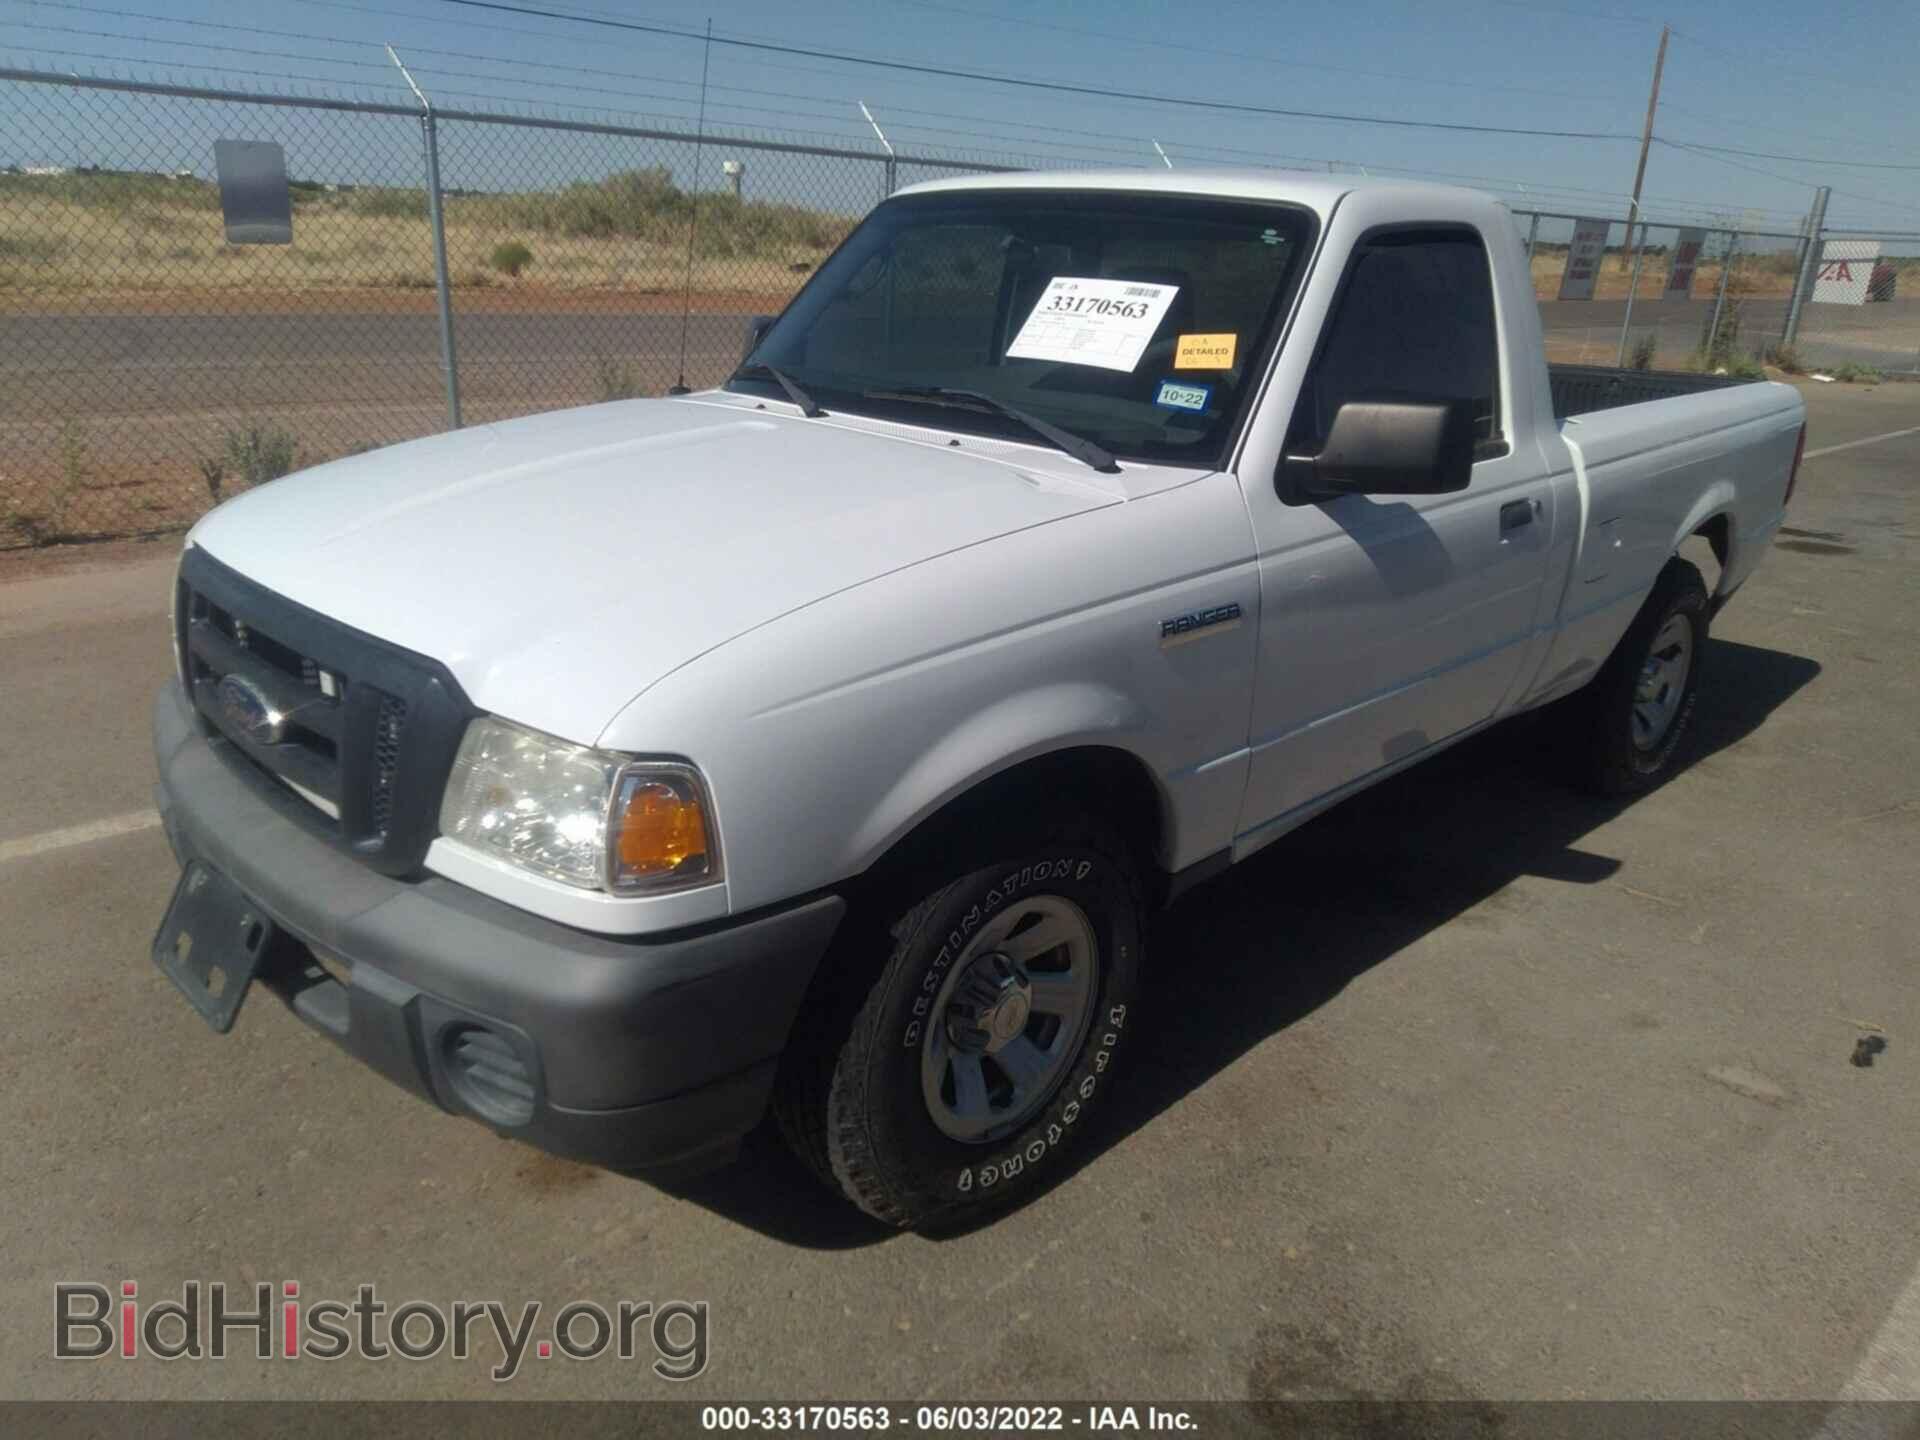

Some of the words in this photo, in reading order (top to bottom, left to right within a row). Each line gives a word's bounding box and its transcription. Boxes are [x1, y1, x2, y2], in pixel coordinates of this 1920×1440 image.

[1047, 295, 1150, 319] 33170563
[1182, 347, 1229, 357] DETAILED
[1161, 603, 1241, 638] RANGER
[903, 858, 1073, 1048] DESTINATION
